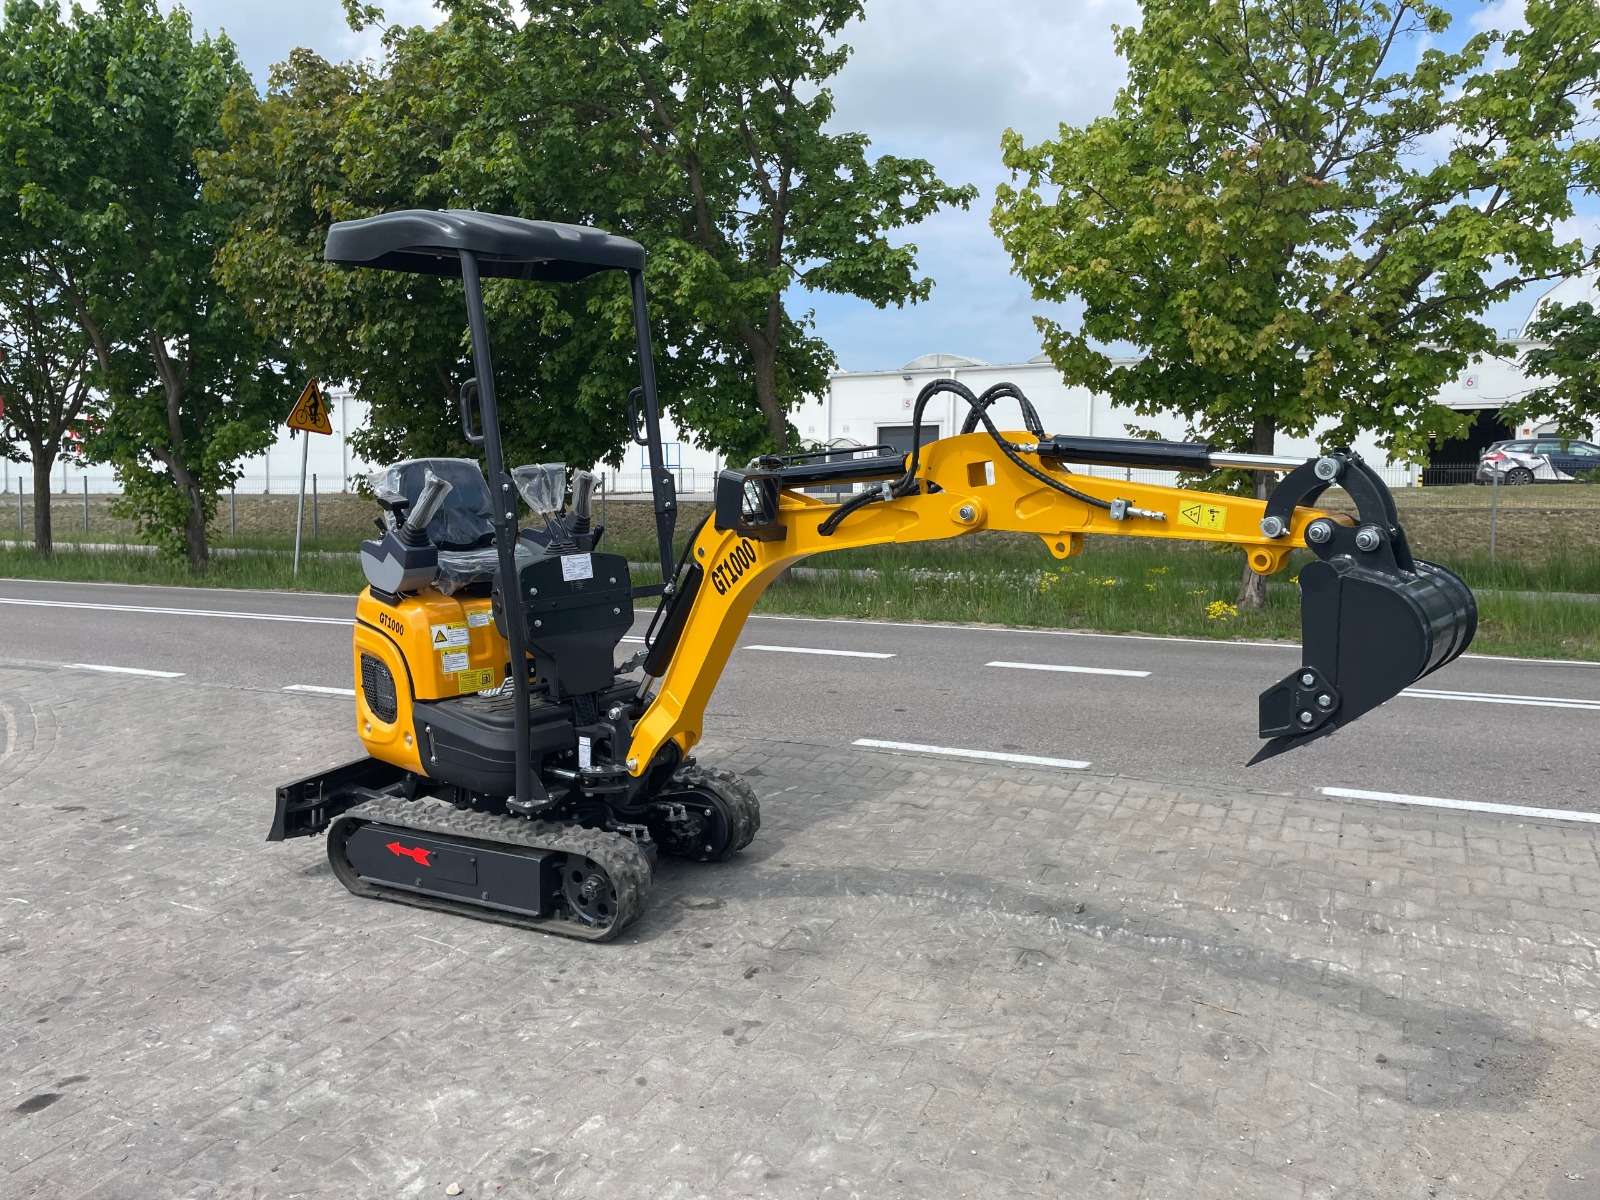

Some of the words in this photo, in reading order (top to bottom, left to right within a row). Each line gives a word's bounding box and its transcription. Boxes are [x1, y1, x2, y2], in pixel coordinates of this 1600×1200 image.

[1466, 377, 1474, 387] 6
[905, 399, 911, 408] 5
[711, 538, 757, 595] GT1000
[379, 612, 404, 636] GT1000
